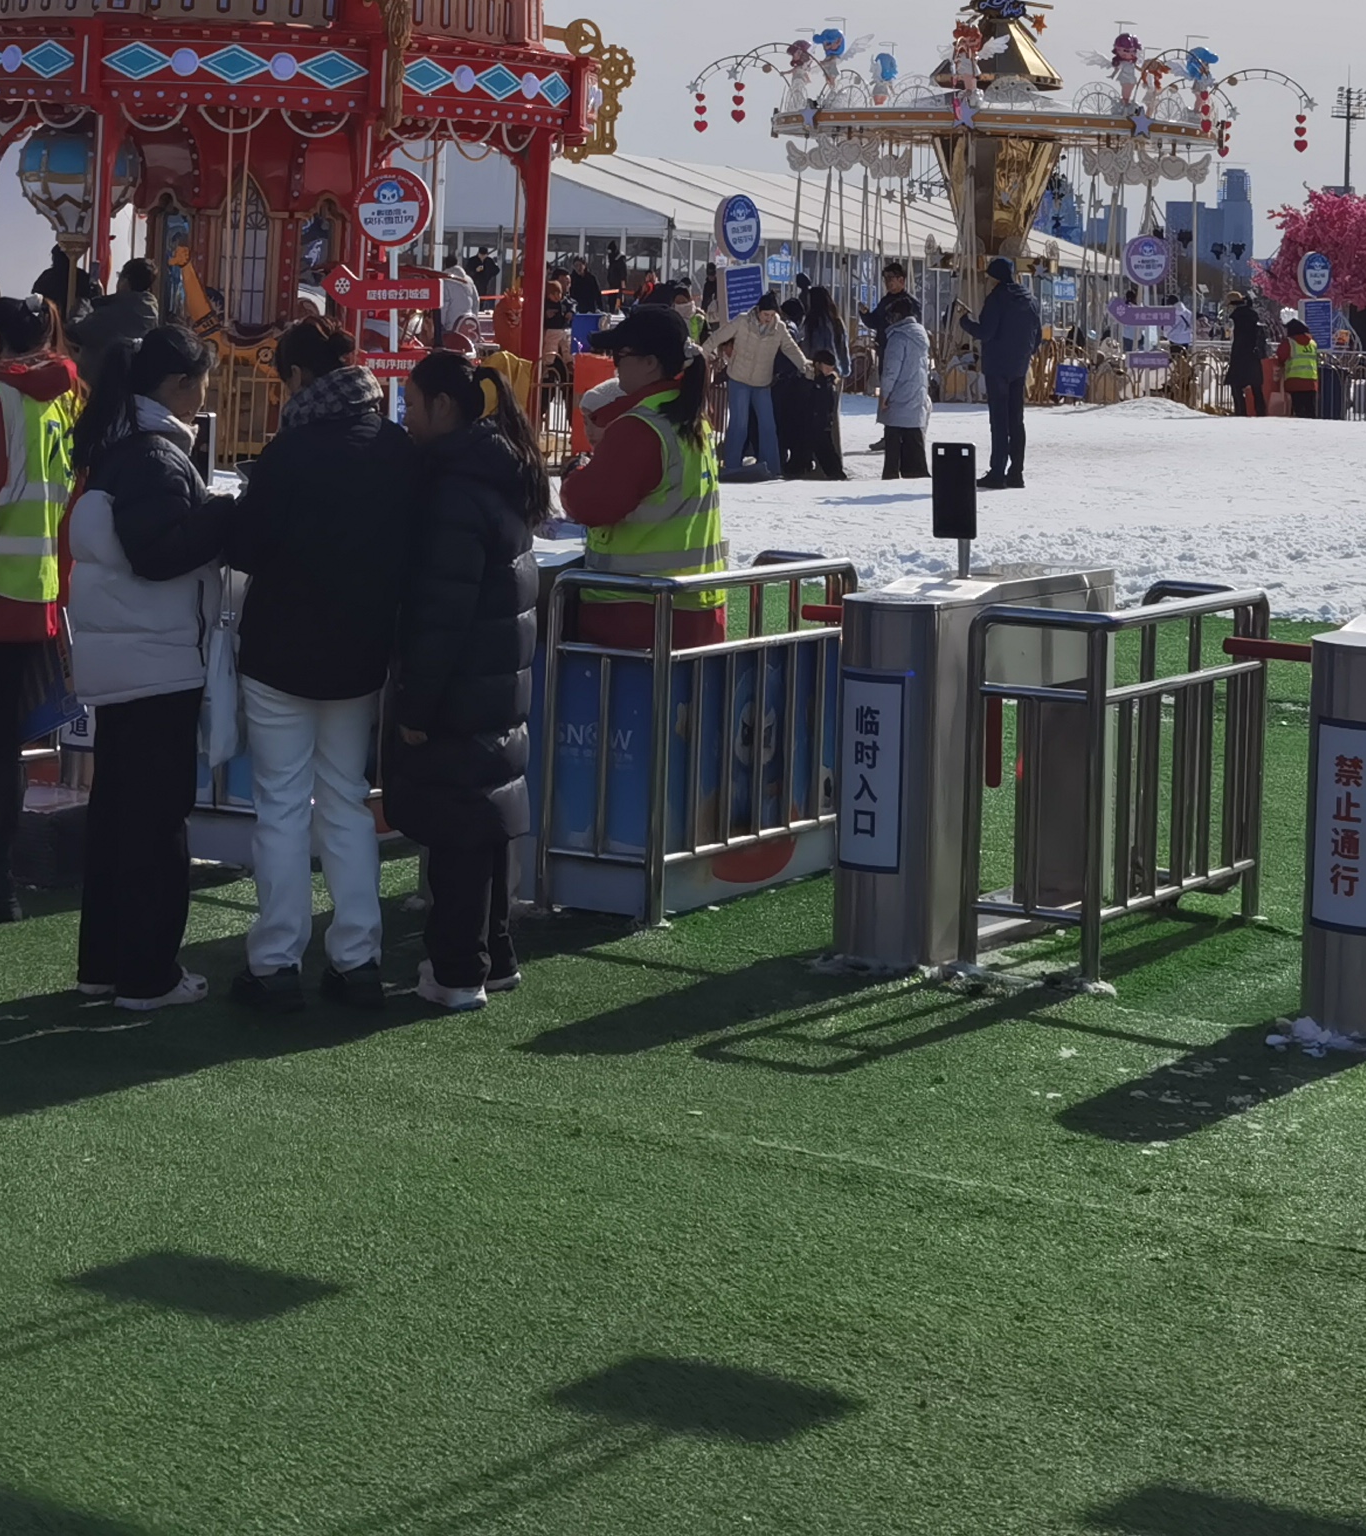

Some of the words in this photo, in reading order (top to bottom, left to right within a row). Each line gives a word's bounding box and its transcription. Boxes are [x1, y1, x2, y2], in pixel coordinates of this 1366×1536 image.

[853, 705, 880, 838] 临时入口
[1330, 755, 1363, 897] 禁止通行
